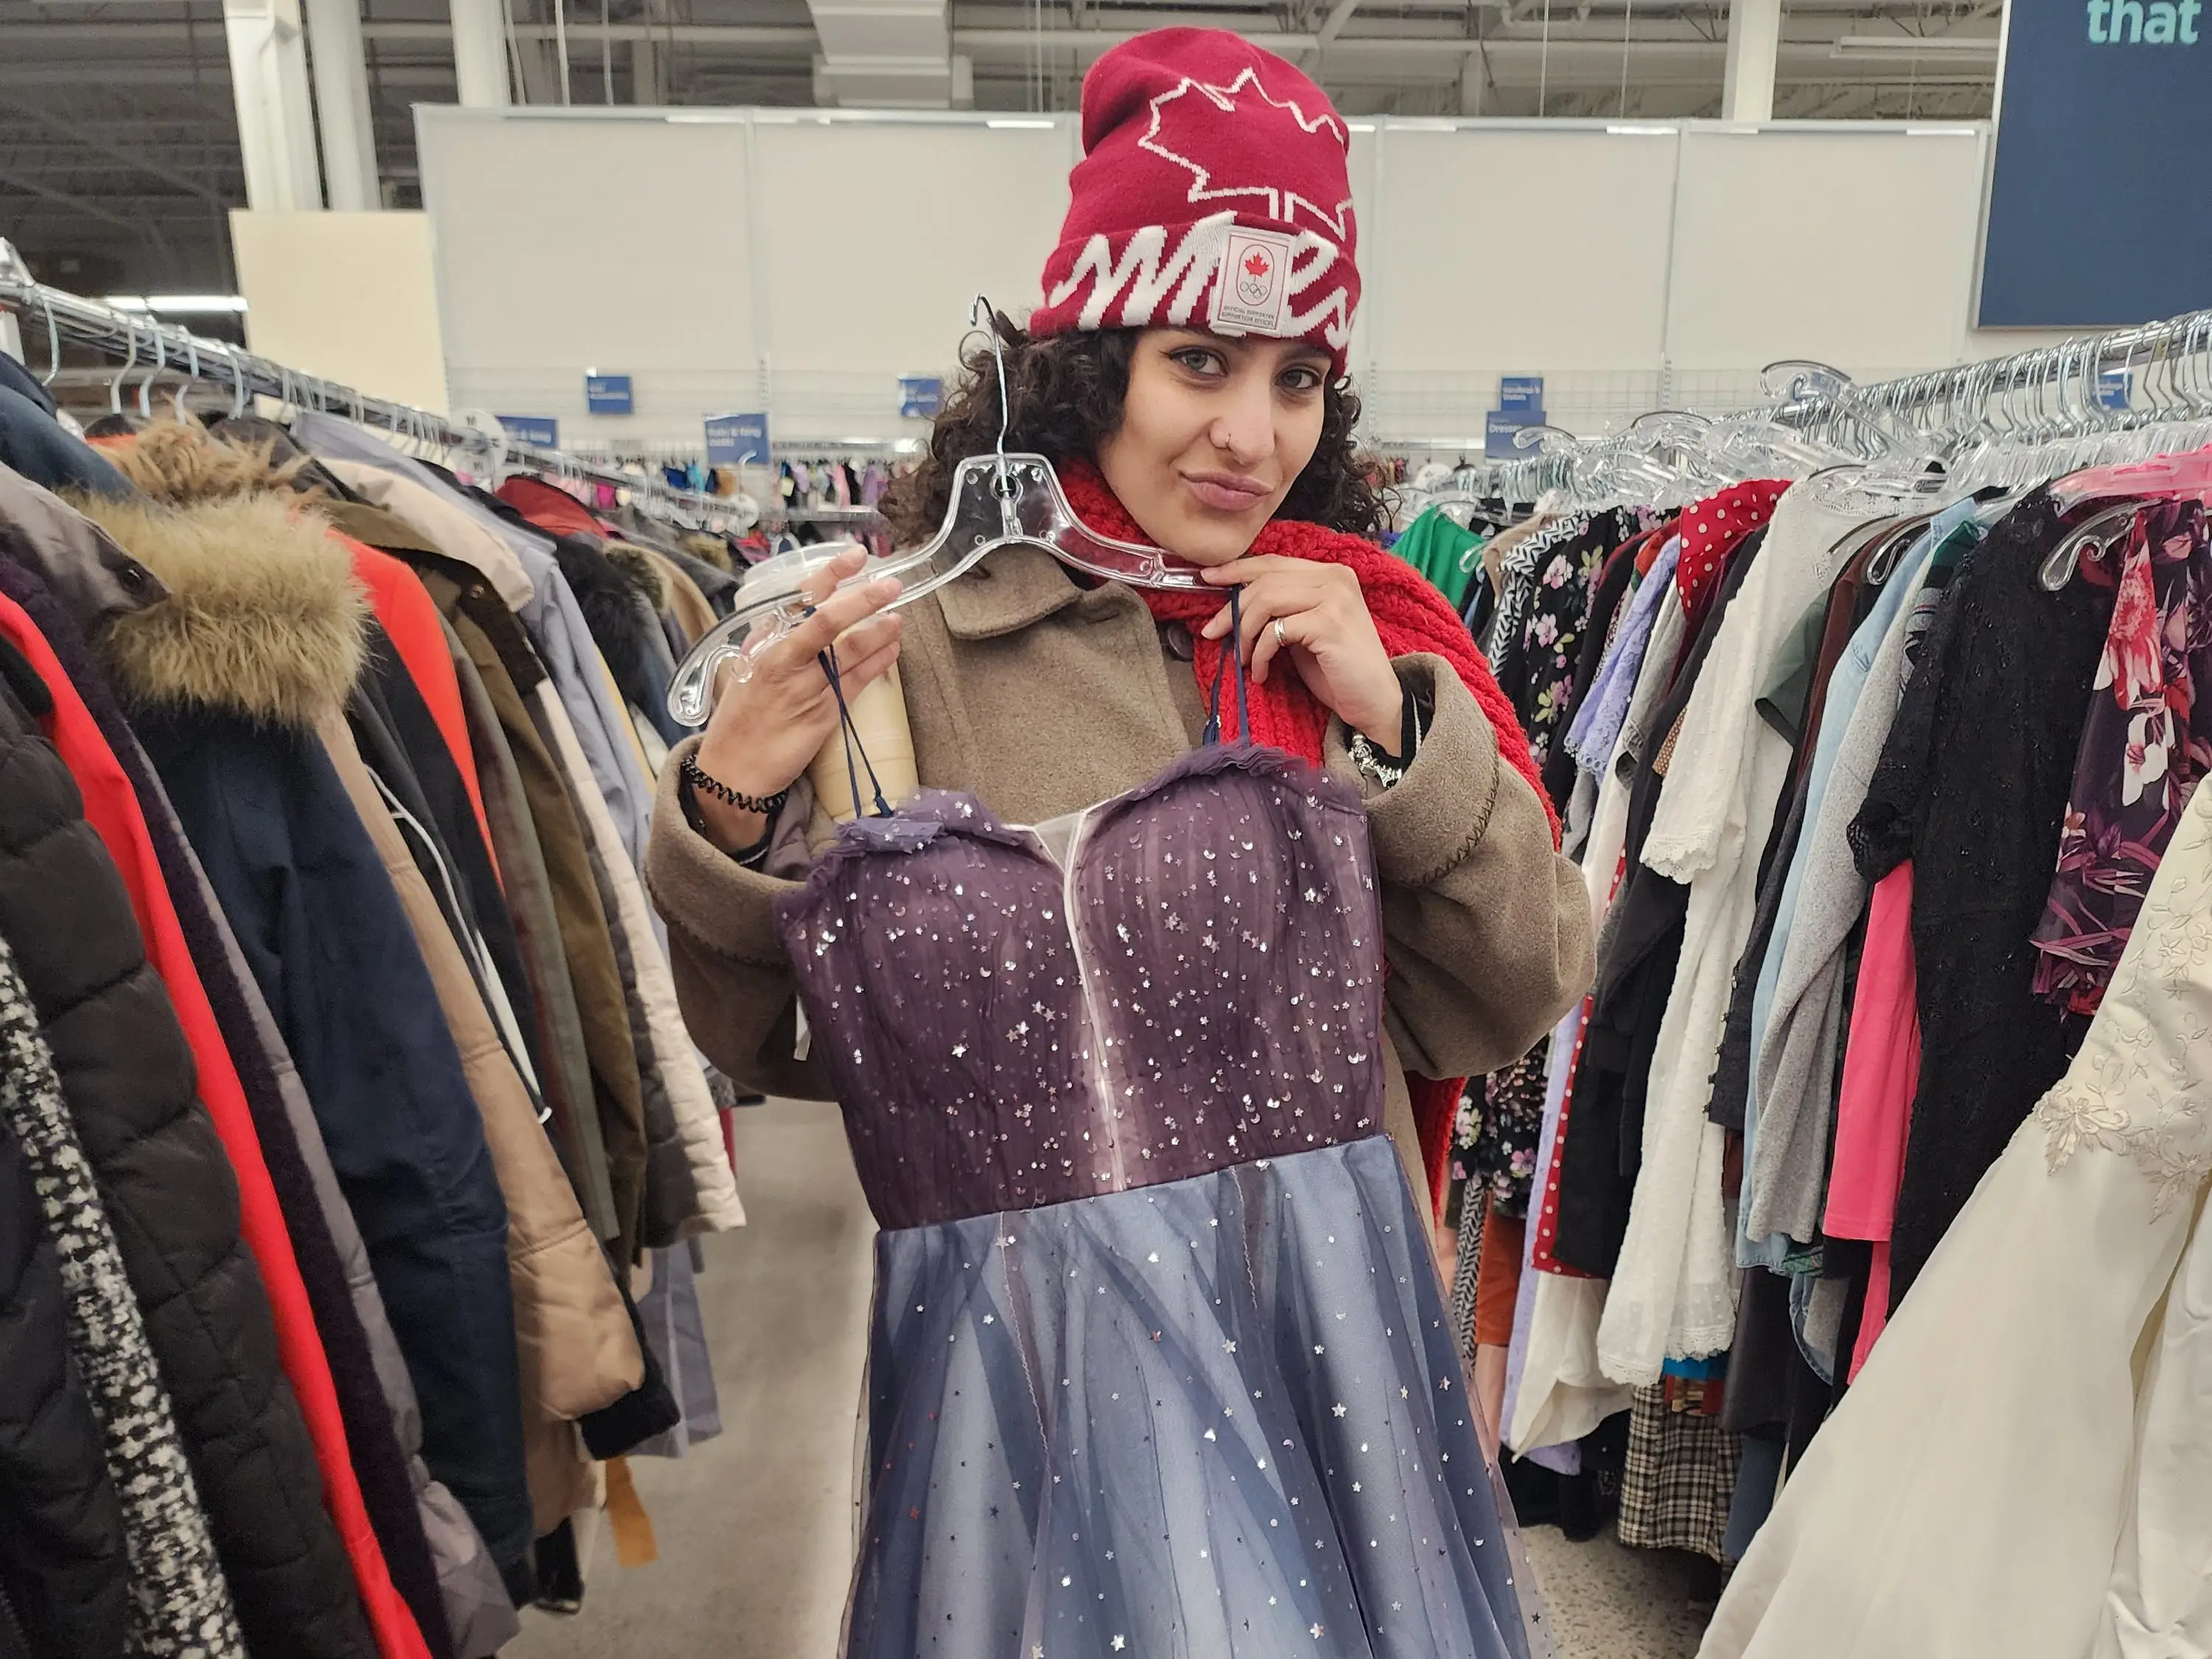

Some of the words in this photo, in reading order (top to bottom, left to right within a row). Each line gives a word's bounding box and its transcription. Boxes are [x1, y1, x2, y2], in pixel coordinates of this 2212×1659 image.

[2087, 0, 2202, 44] that
[1224, 306, 1245, 314] OFFICIAL
[1247, 310, 1275, 320] SUPPORTER
